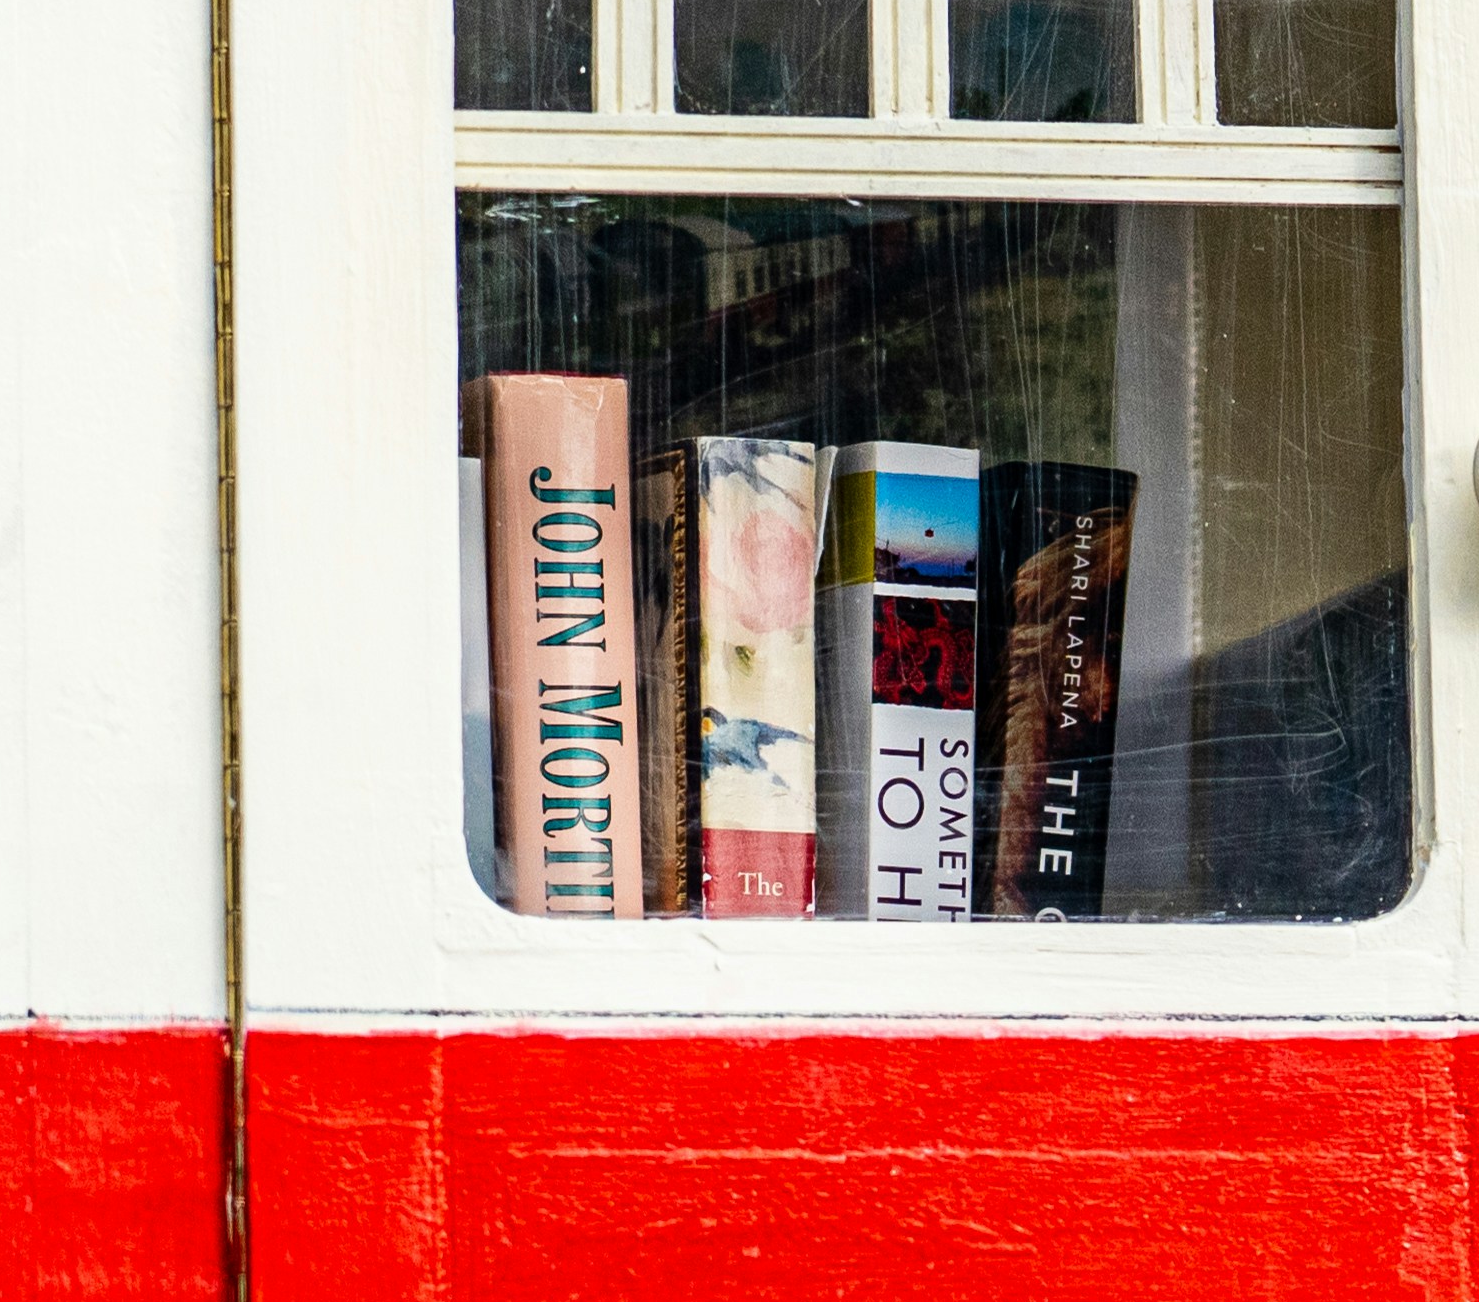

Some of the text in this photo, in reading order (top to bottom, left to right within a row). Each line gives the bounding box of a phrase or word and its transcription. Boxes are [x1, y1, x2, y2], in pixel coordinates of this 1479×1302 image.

[529, 465, 616, 653] JOHN
[1059, 515, 1094, 729] SHARI LAPENA
[877, 737, 925, 830] TO
[1038, 769, 1079, 876] THE
[737, 871, 784, 897] The
